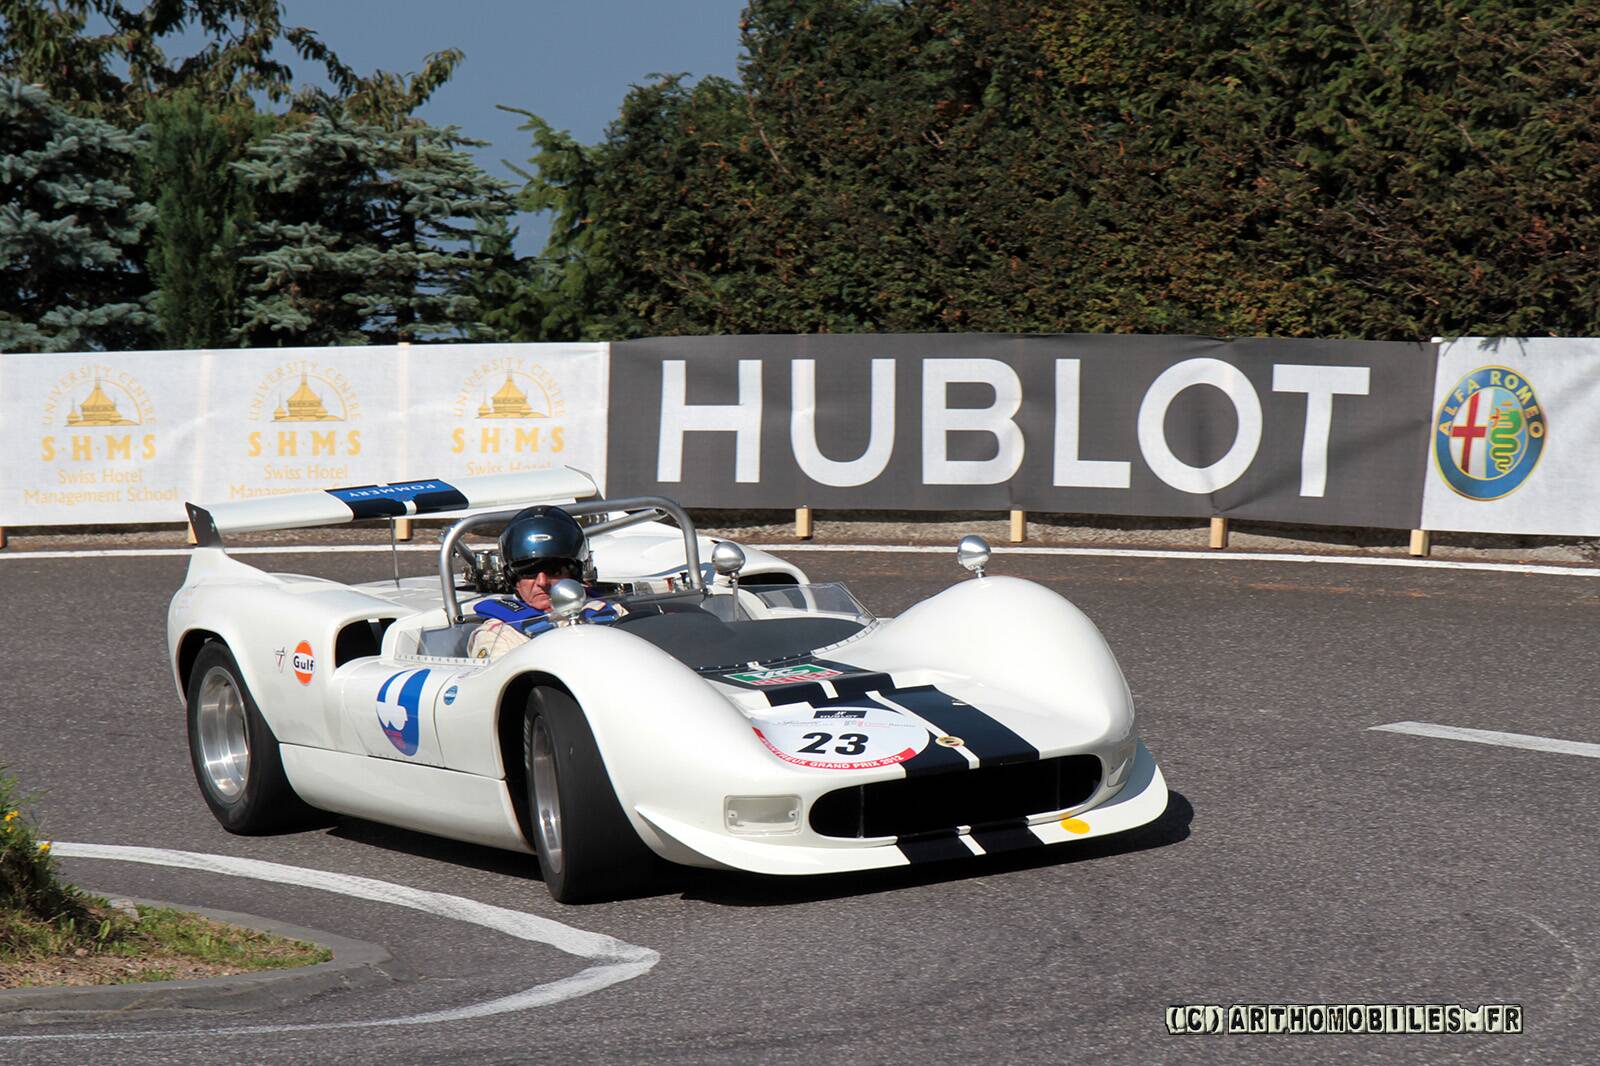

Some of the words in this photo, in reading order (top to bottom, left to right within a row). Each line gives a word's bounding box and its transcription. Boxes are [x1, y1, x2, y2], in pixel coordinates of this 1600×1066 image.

[1439, 379, 1480, 436] ALFA
[1490, 370, 1545, 439] ROMEO
[656, 357, 1371, 498] HUBLOT
[57, 469, 97, 485] Swiss
[102, 467, 144, 484] Hotel
[263, 464, 301, 481] Swiss
[307, 463, 349, 480] Hotel
[24, 488, 120, 506] Management
[127, 485, 178, 503] School
[349, 483, 436, 498] POMMERY
[293, 655, 314, 671] Gulf
[797, 732, 869, 755] 23
[810, 761, 850, 769] GRAND
[853, 760, 880, 769] PRIX
[880, 755, 905, 767] 2012
